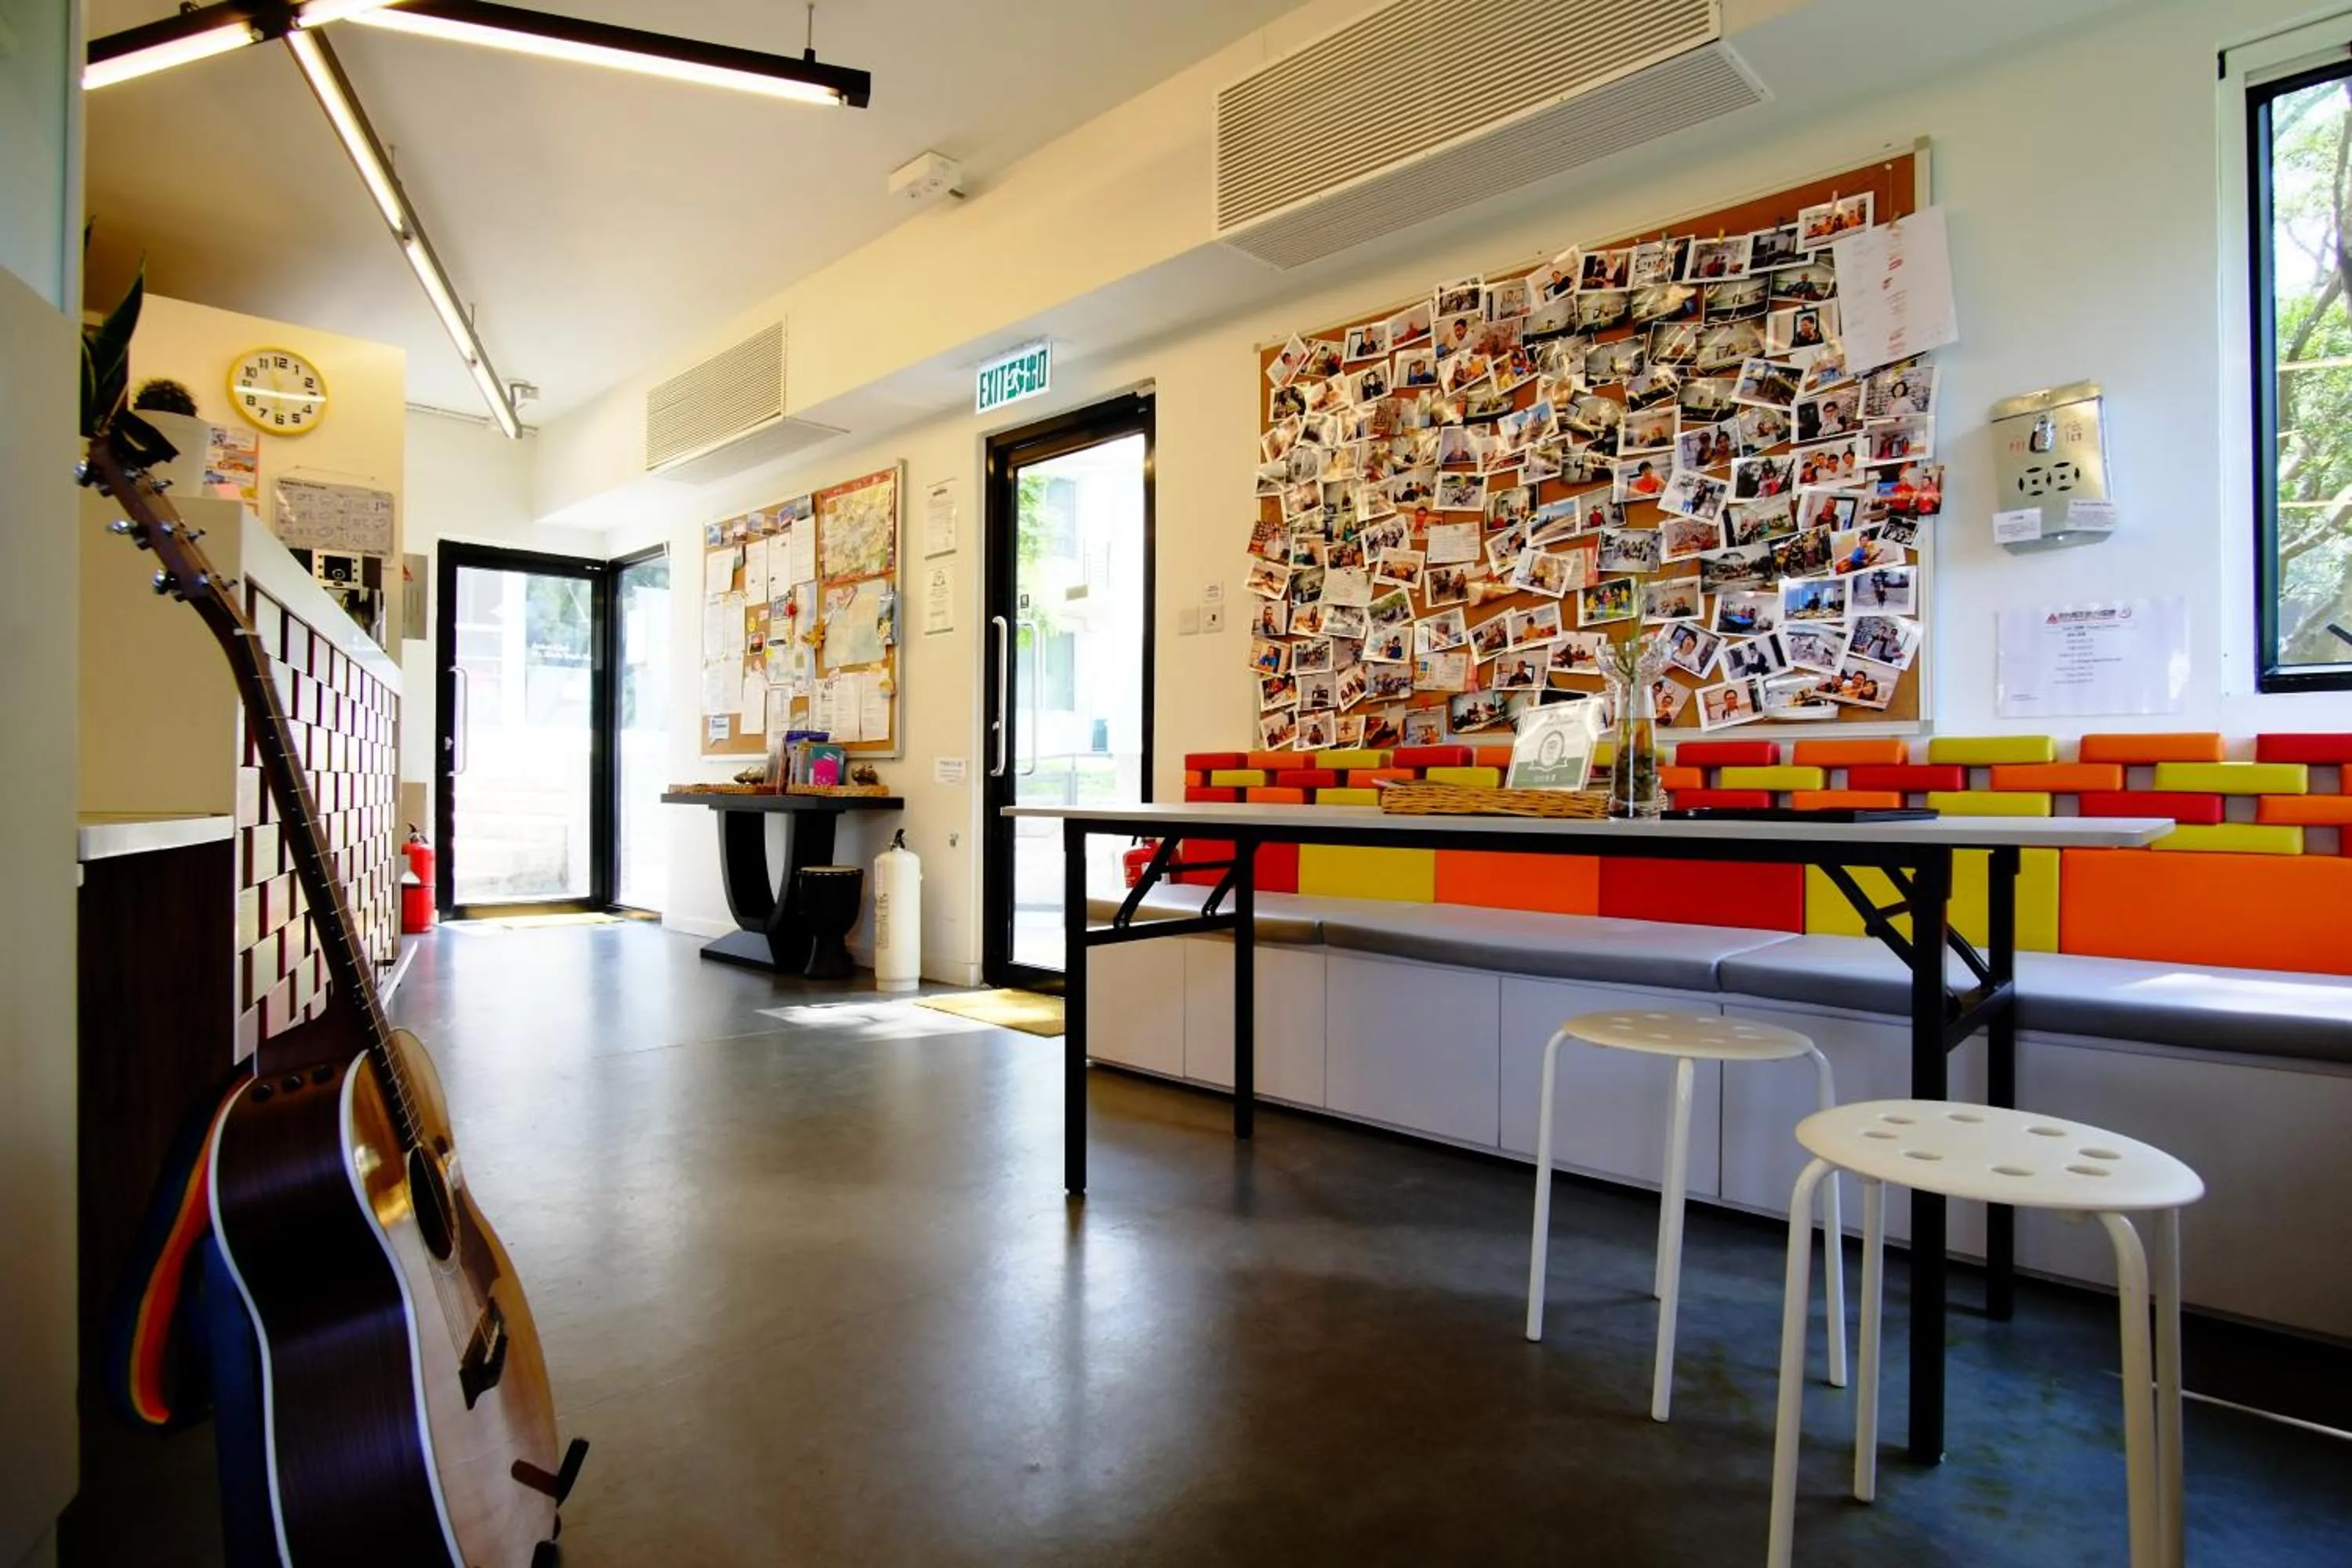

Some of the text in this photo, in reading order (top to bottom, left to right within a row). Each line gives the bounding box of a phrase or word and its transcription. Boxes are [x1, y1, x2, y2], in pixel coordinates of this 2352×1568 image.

[260, 358, 268, 368] 11
[274, 357, 288, 368] 12
[246, 366, 257, 377] 10
[294, 365, 299, 375] 1
[1025, 350, 1047, 392] 出口
[304, 377, 314, 388] 2
[980, 365, 1007, 408] EXIT
[246, 394, 256, 405] 8
[259, 408, 267, 417] 7
[302, 405, 312, 414] 4
[275, 414, 284, 425] 6
[292, 414, 300, 423] 5
